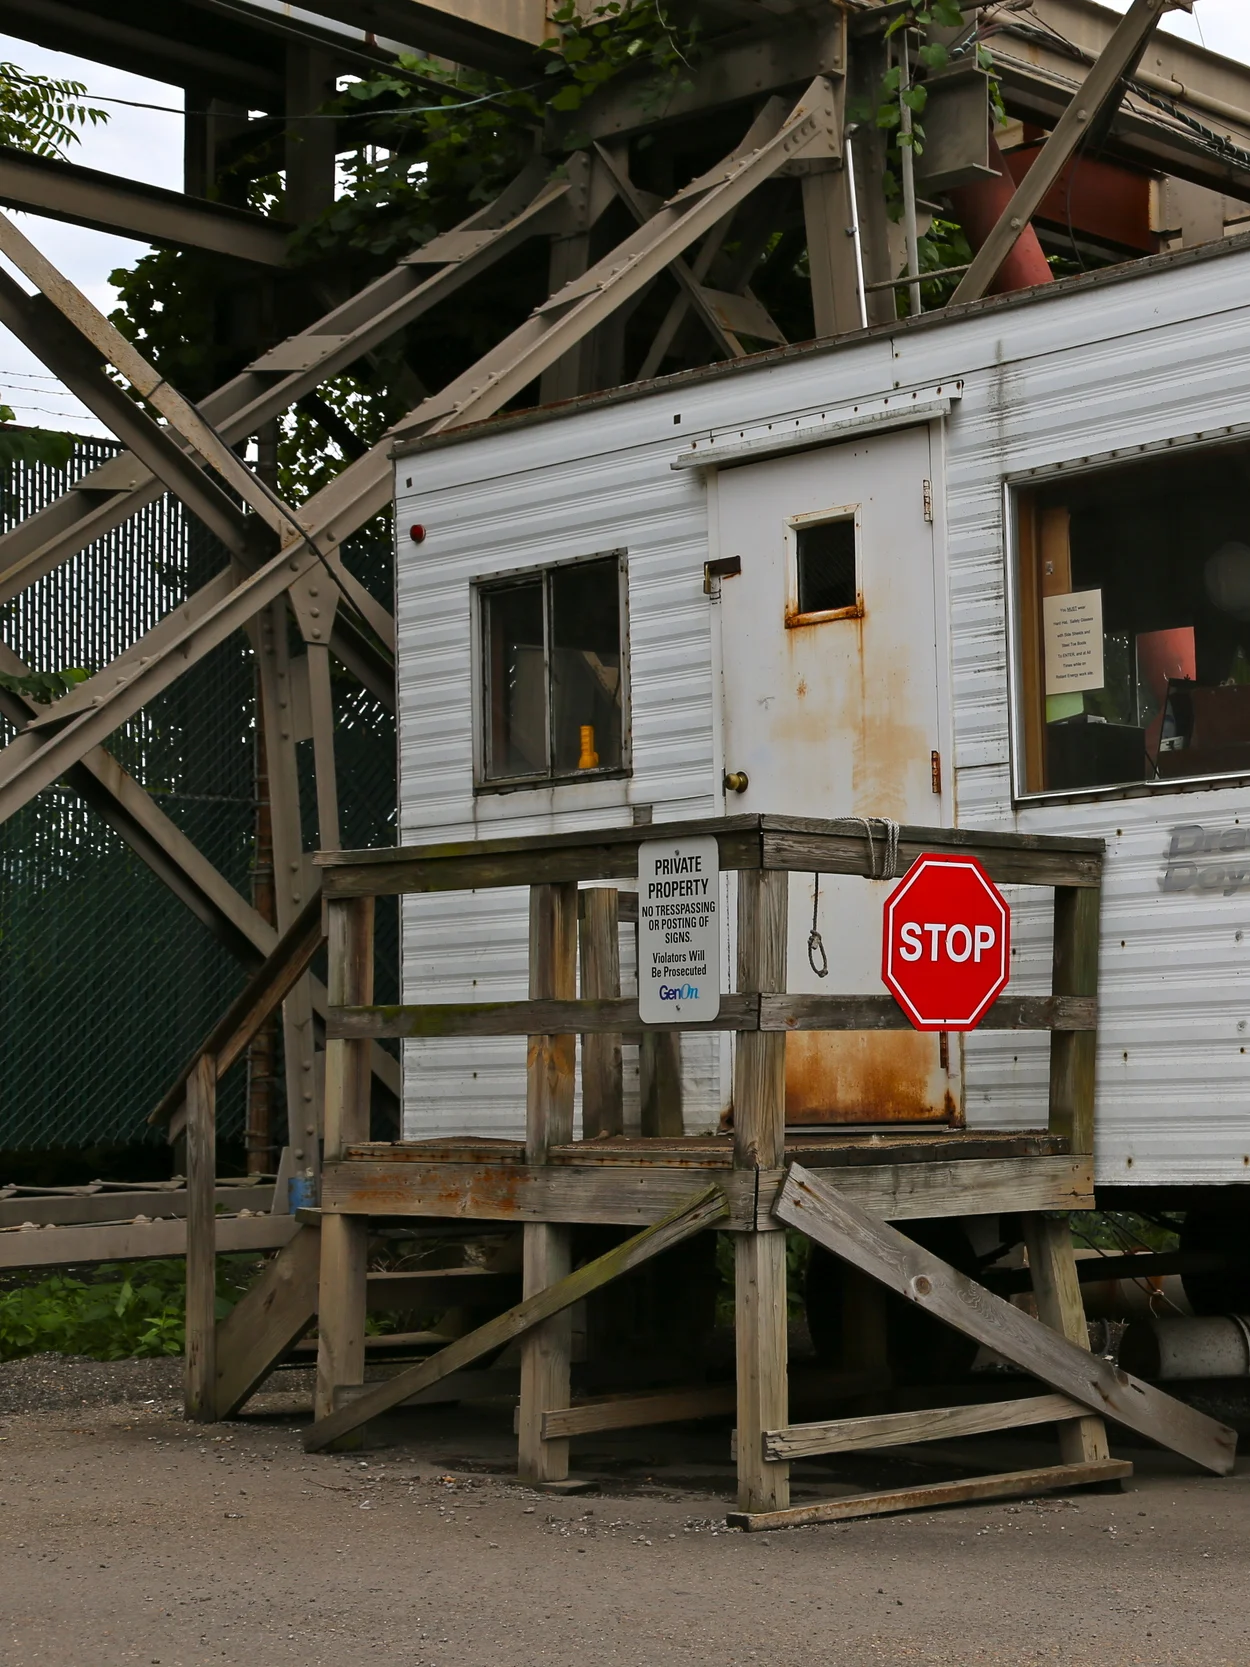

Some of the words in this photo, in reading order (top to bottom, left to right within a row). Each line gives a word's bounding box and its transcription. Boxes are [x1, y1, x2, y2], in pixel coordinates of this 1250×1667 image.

[655, 855, 702, 876] PRIVATE
[648, 878, 709, 899] PROPERTY
[642, 905, 653, 917] NO
[655, 901, 715, 916] TRESSPASSING
[648, 919, 659, 931] OR
[661, 916, 697, 930] POSTING
[699, 915, 709, 927] OF
[665, 931, 692, 944] SIGNS.
[899, 921, 996, 963] STOP
[652, 952, 687, 964] Violators
[689, 949, 705, 962] Will
[651, 966, 662, 978] Be
[664, 964, 707, 977] Prosecuted
[659, 983, 699, 1001] GenOn
